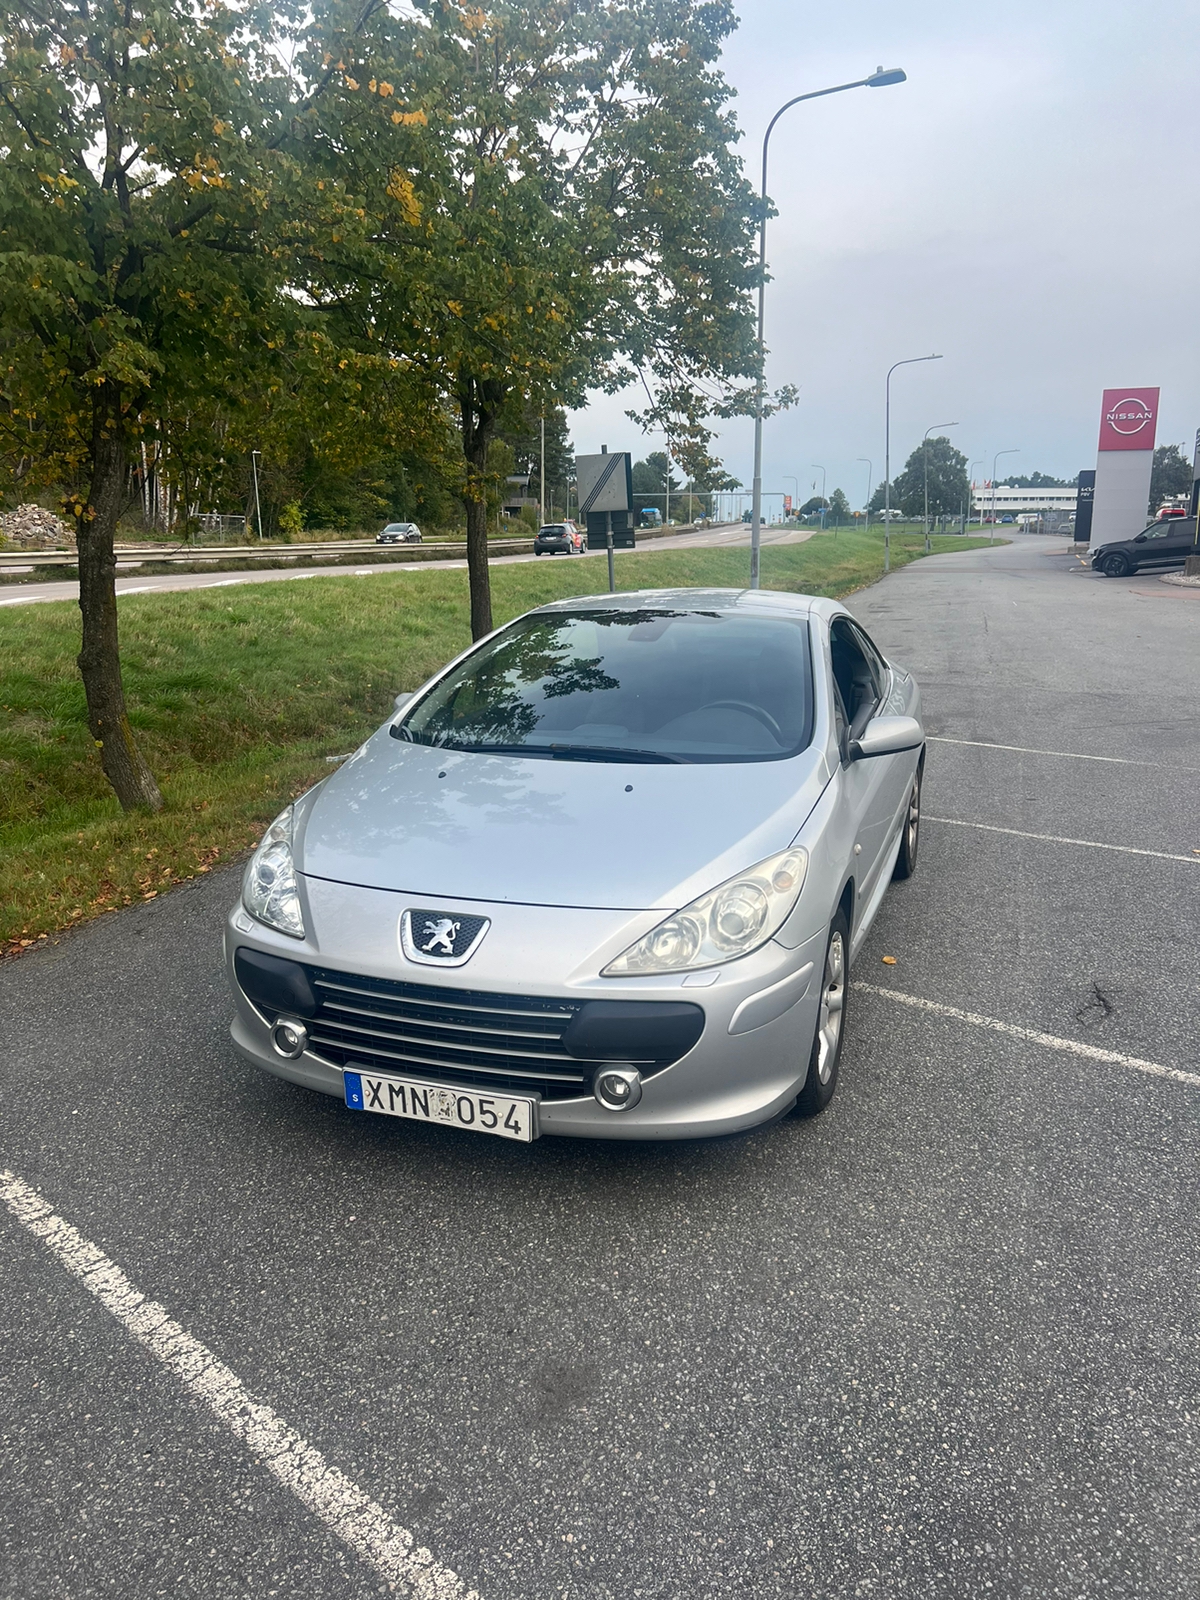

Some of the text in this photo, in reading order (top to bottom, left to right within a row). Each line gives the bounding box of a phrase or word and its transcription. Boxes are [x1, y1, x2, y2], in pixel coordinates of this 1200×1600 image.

[1106, 412, 1153, 421] NISSAN
[352, 1094, 359, 1102] S
[366, 1079, 522, 1135] XMN 054
